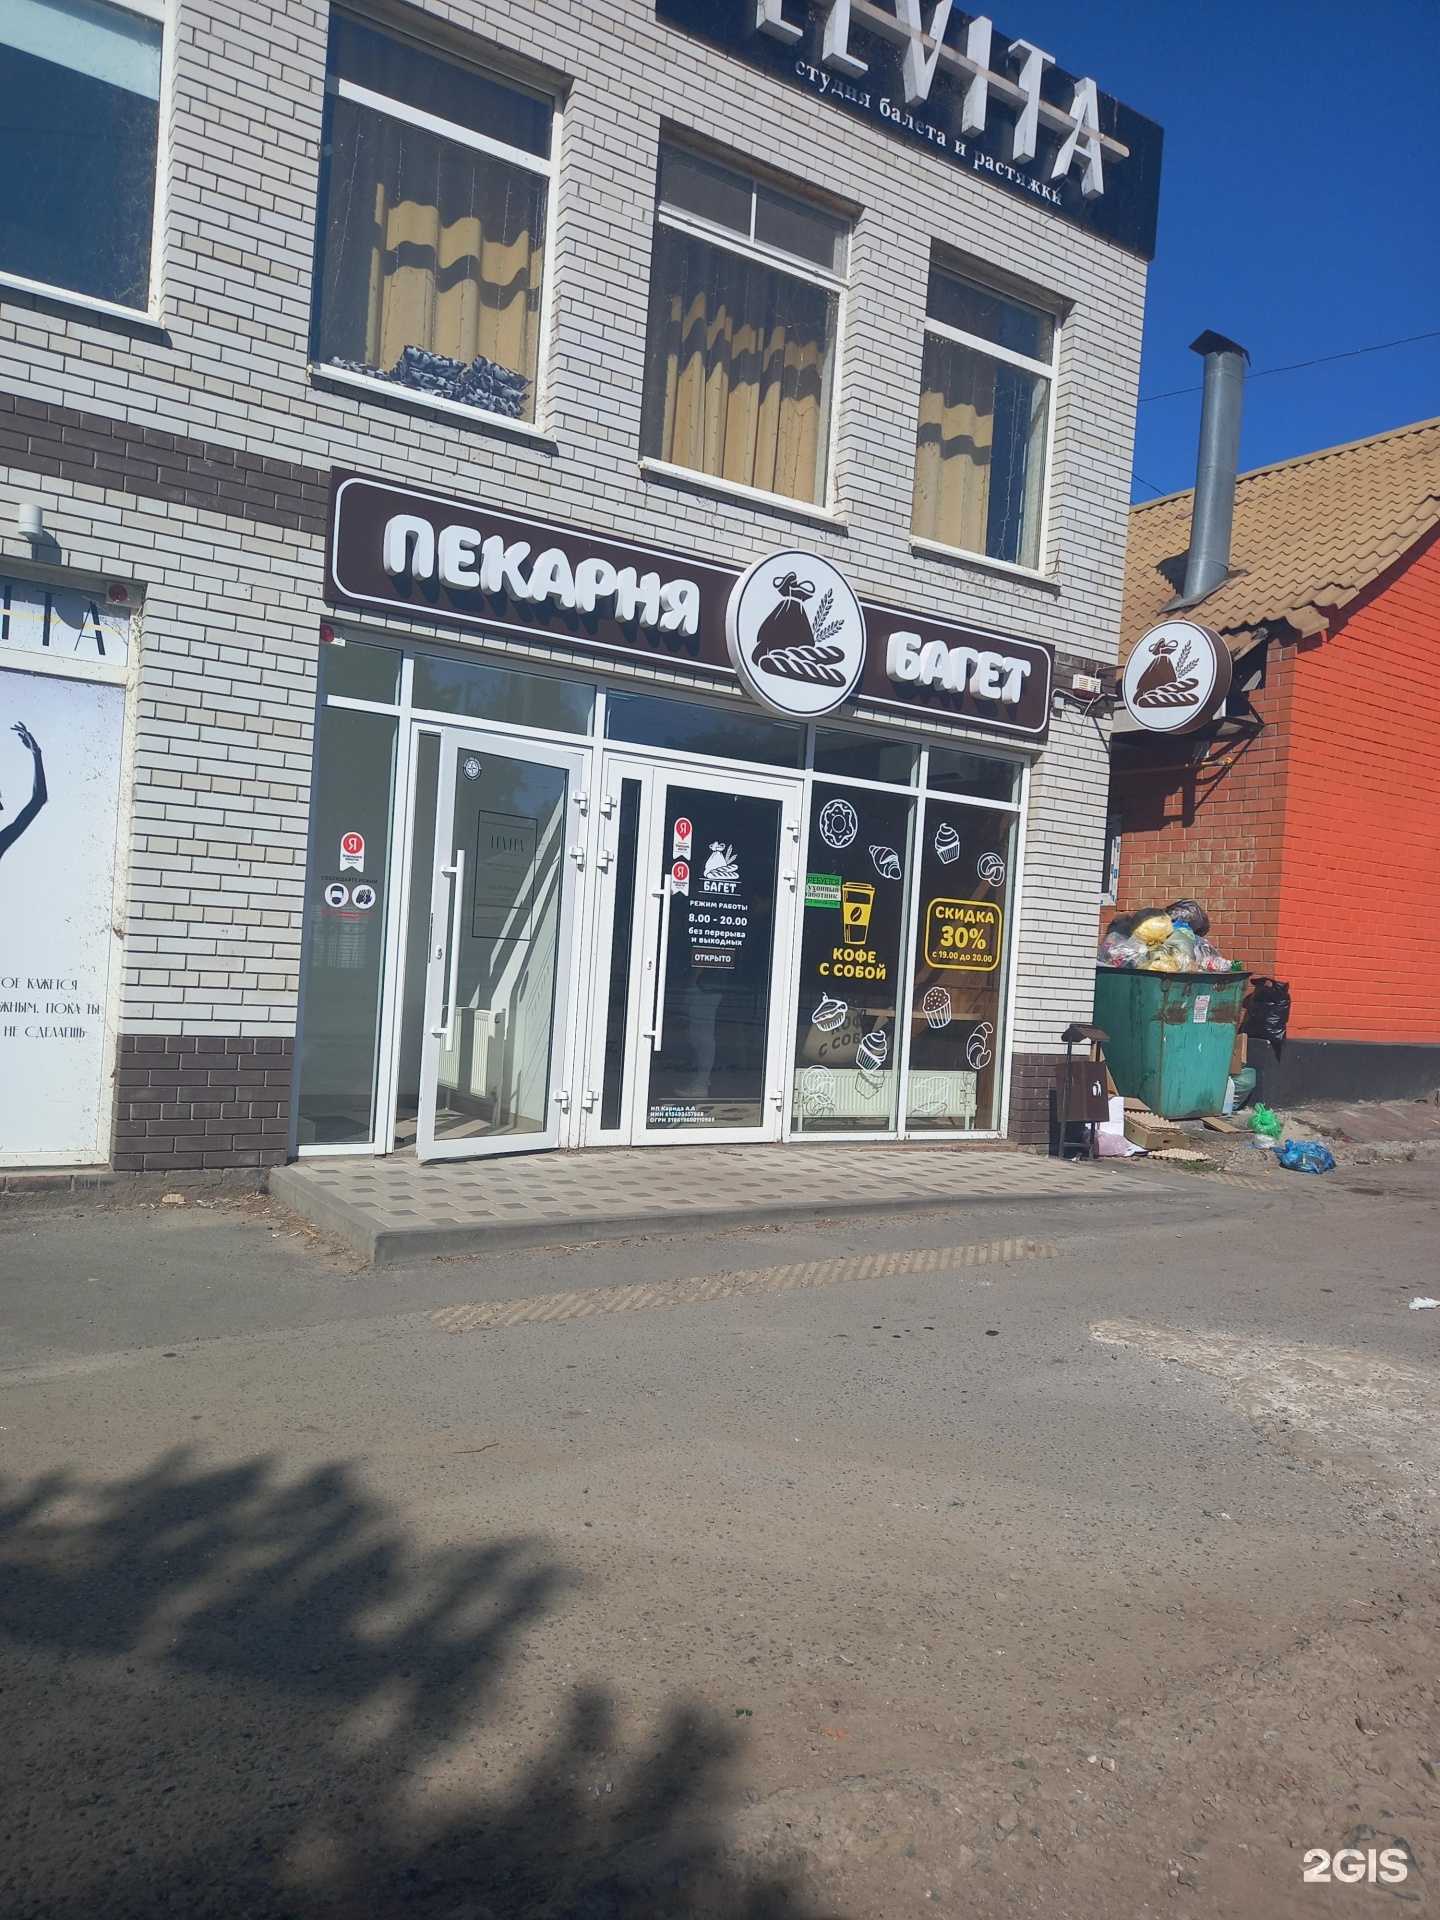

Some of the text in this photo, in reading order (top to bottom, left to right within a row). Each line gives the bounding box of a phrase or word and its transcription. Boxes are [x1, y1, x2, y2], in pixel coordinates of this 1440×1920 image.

[879, 97, 947, 147] балета
[954, 139, 968, 157] и
[383, 514, 700, 637] ПЕКАРНЯ
[886, 631, 1032, 704] БАГЕТ
[348, 837, 358, 851] Я
[703, 880, 737, 893] БАГЕТ
[689, 900, 748, 911] РЕЖИМ РАБОТЫ
[688, 913, 711, 923] 8.00
[720, 915, 748, 926] 20.00
[935, 906, 995, 924] СКИДКА
[688, 927, 746, 938] без перерыва
[940, 925, 986, 950] 30%
[698, 937, 743, 946] выходных
[694, 953, 732, 963] ОТКРЫТО
[832, 947, 877, 963] КОФЕ
[938, 950, 958, 959] 19.00
[972, 953, 993, 962] 20.00
[819, 962, 886, 980] С СОБОЙ
